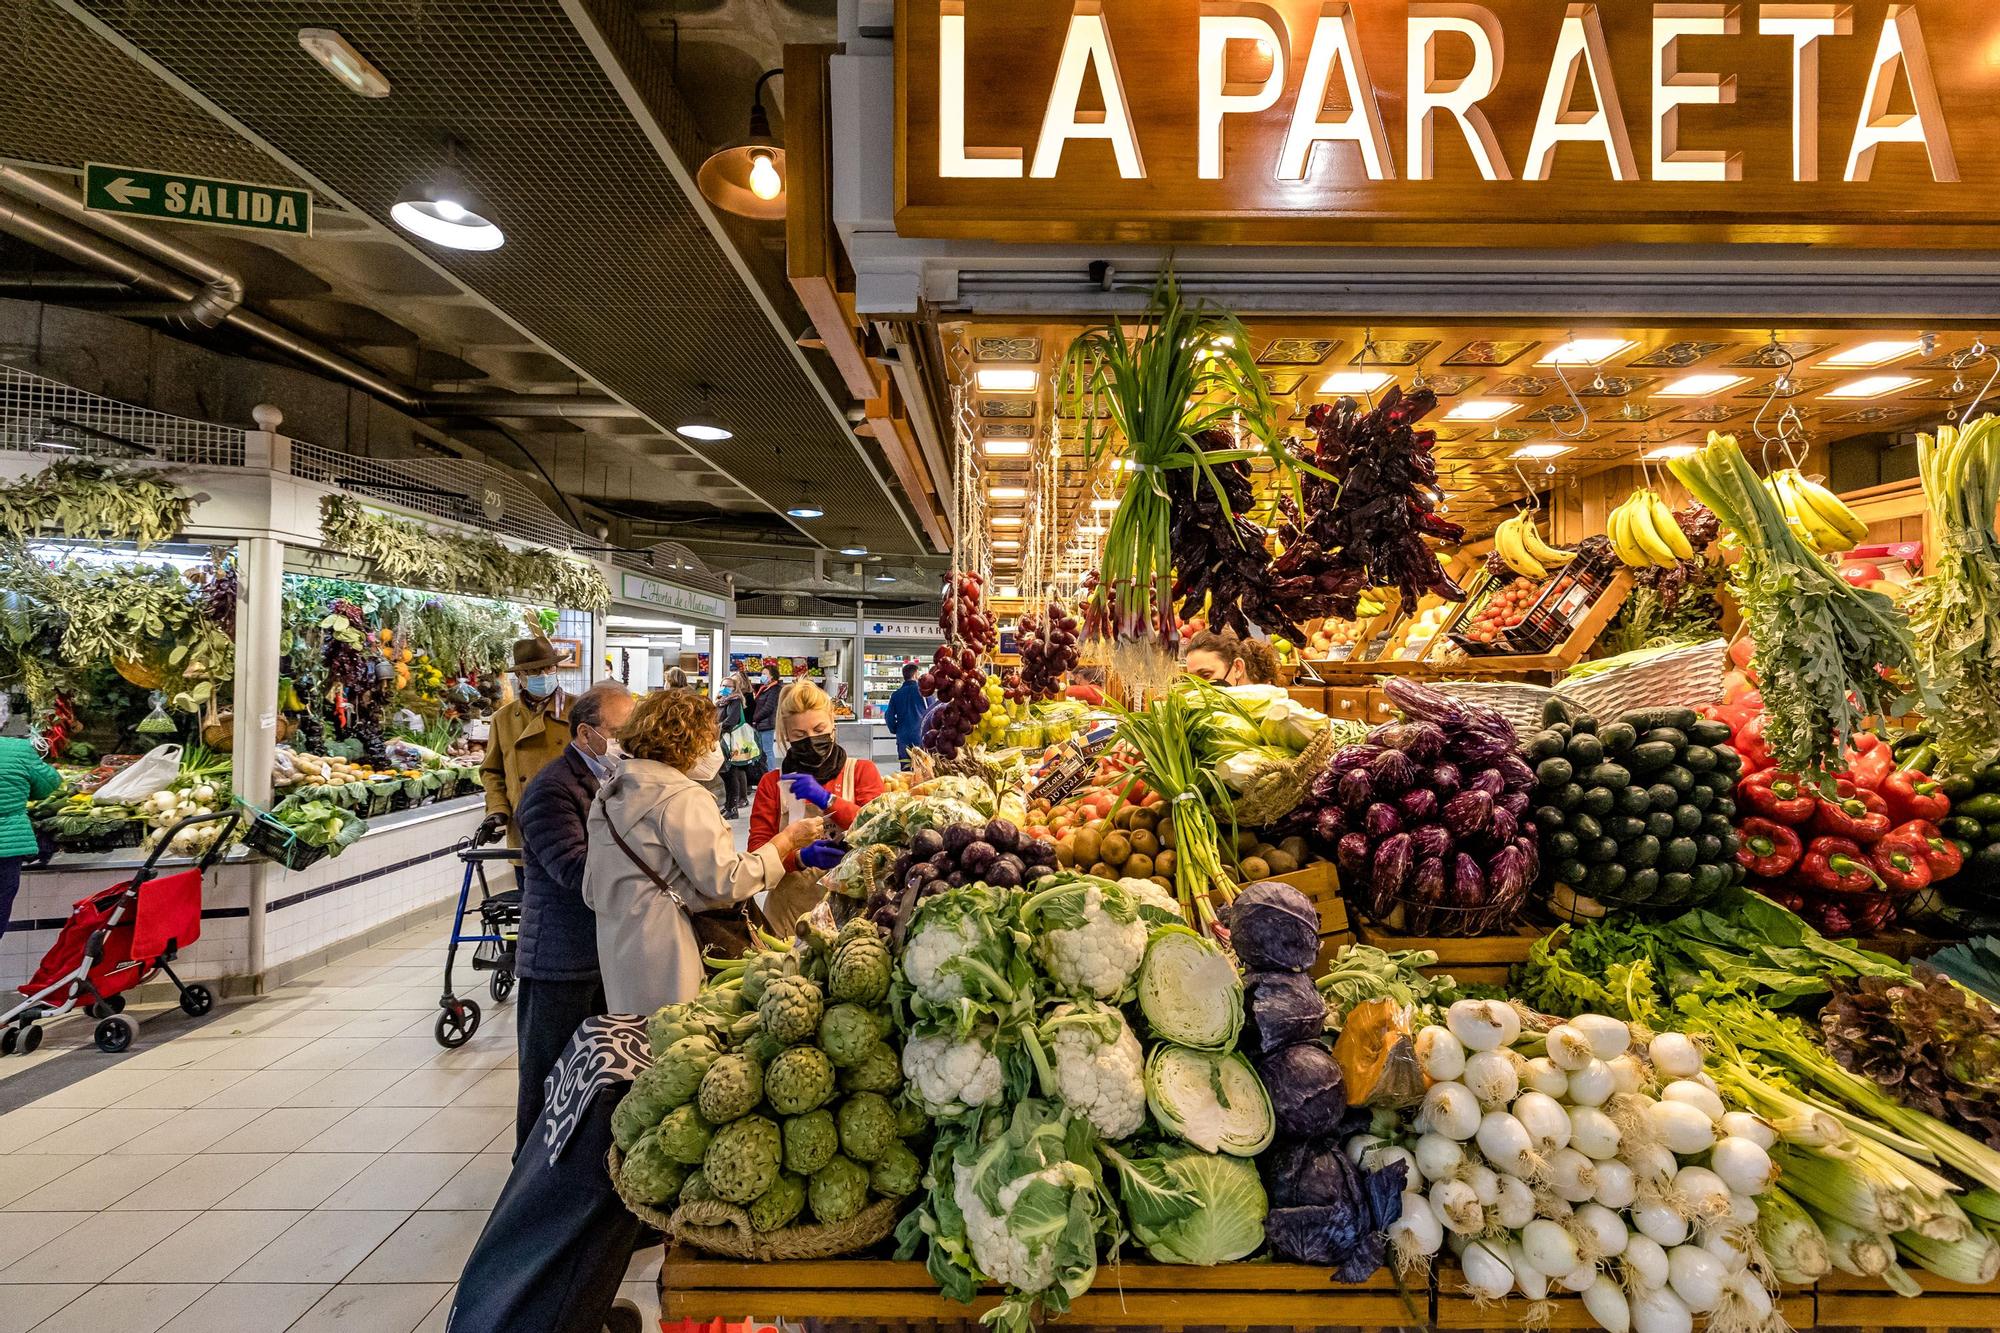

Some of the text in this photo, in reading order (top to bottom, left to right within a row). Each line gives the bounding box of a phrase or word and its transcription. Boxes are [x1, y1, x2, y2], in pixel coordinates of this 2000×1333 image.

[939, 3, 1960, 181] LA PARAETA
[164, 181, 298, 227] SALIDA
[484, 489, 501, 508] 293
[887, 625, 942, 635] PARAFAR
